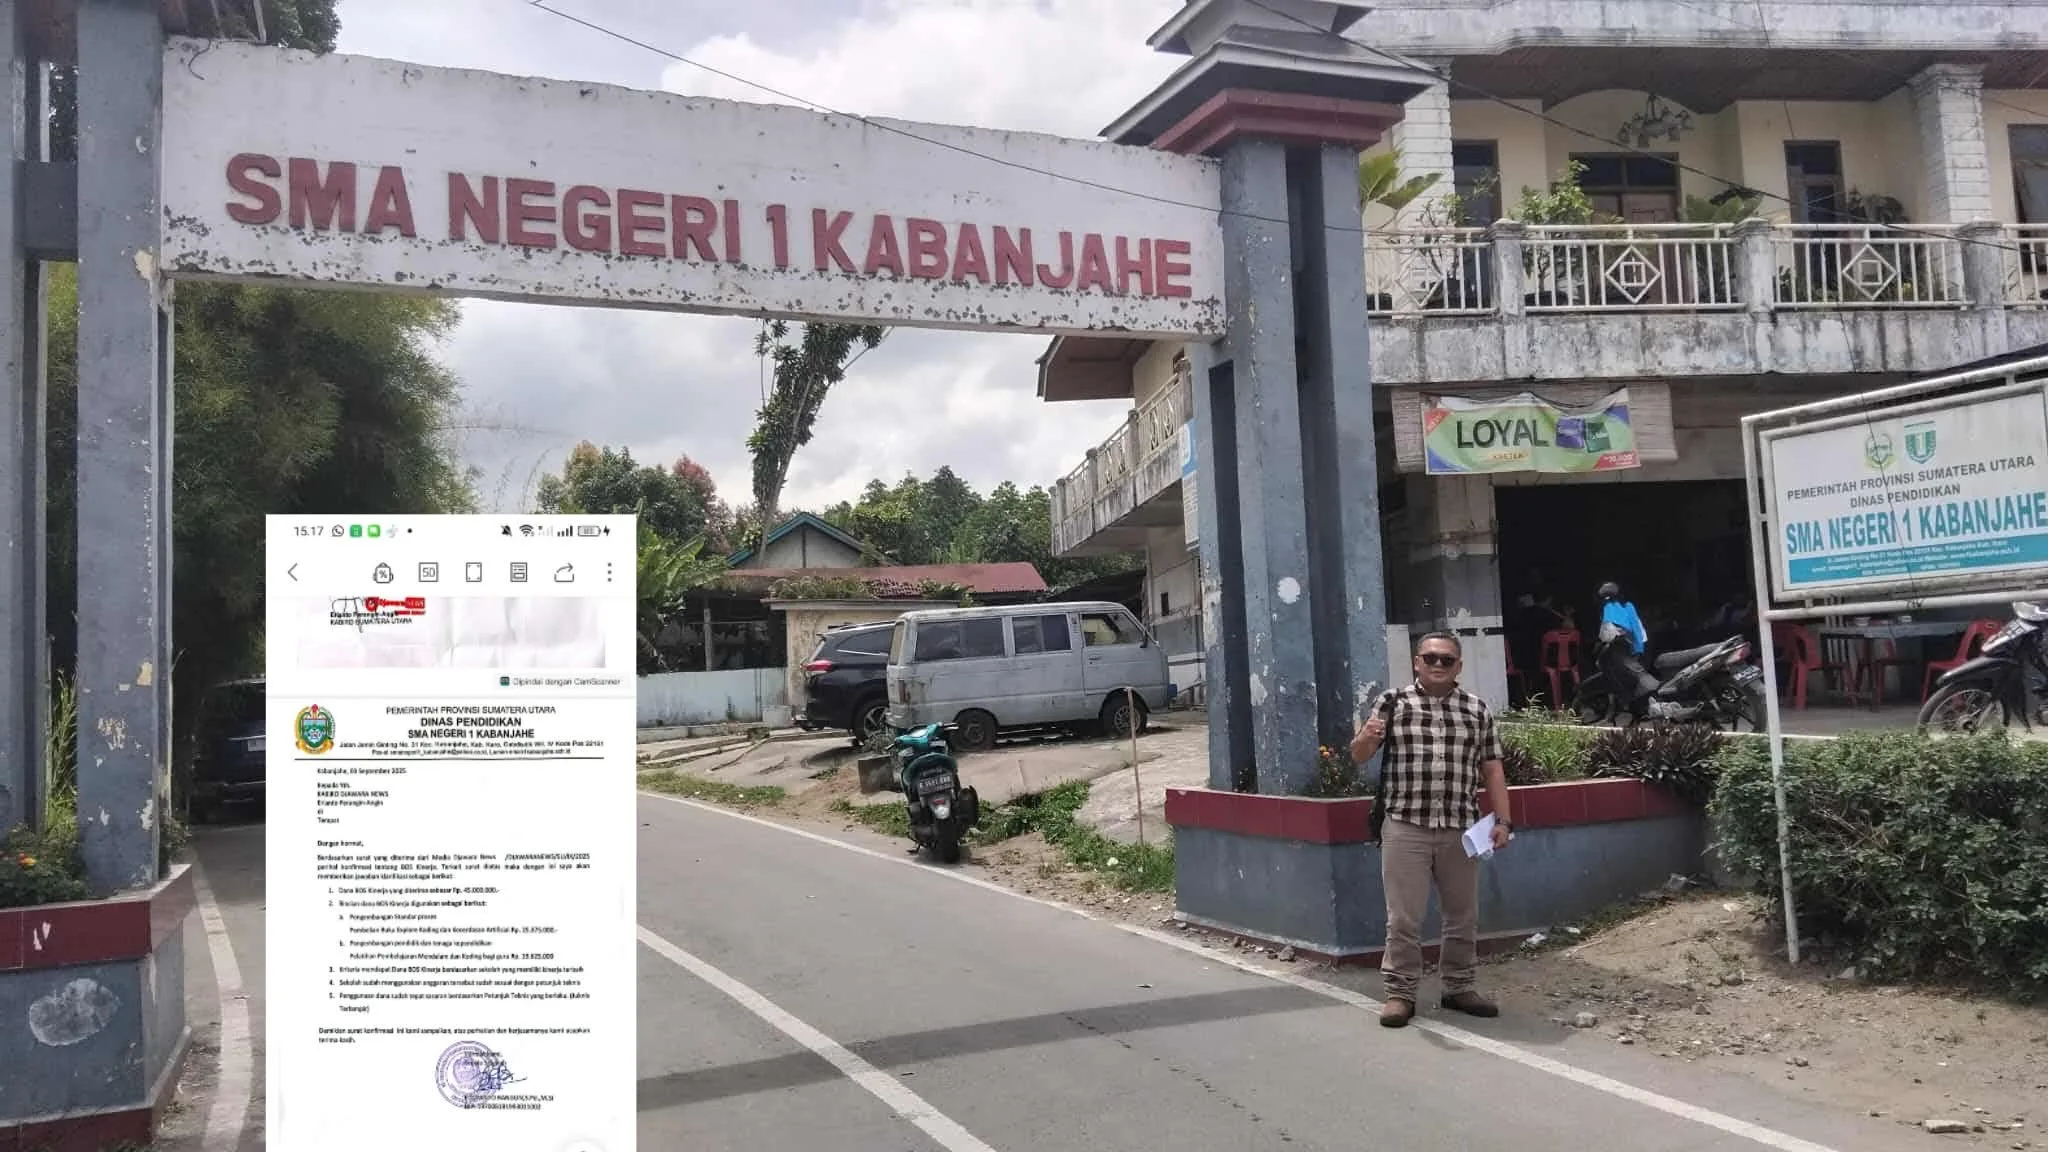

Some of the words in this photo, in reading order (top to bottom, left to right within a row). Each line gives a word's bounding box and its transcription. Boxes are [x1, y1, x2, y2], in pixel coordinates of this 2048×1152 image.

[225, 153, 417, 238] SMA
[448, 172, 740, 263] NEGERI
[766, 203, 789, 267] 1
[811, 208, 1192, 298] KABANJAHE
[1456, 419, 1550, 449] LOYAL
[1787, 482, 1857, 500] PEMERINTAH
[1860, 472, 1914, 490] PROVINSI
[1918, 462, 1986, 481] SUMATERA
[1990, 455, 2035, 472] UTARA
[1850, 495, 1884, 508] DINAS
[1887, 484, 1961, 503] PENDIDIKAN
[1786, 520, 1824, 554] SMA
[1828, 511, 1897, 549] NEGERI
[1902, 508, 1913, 541] 1
[1919, 492, 2048, 539] KABANJAHE
